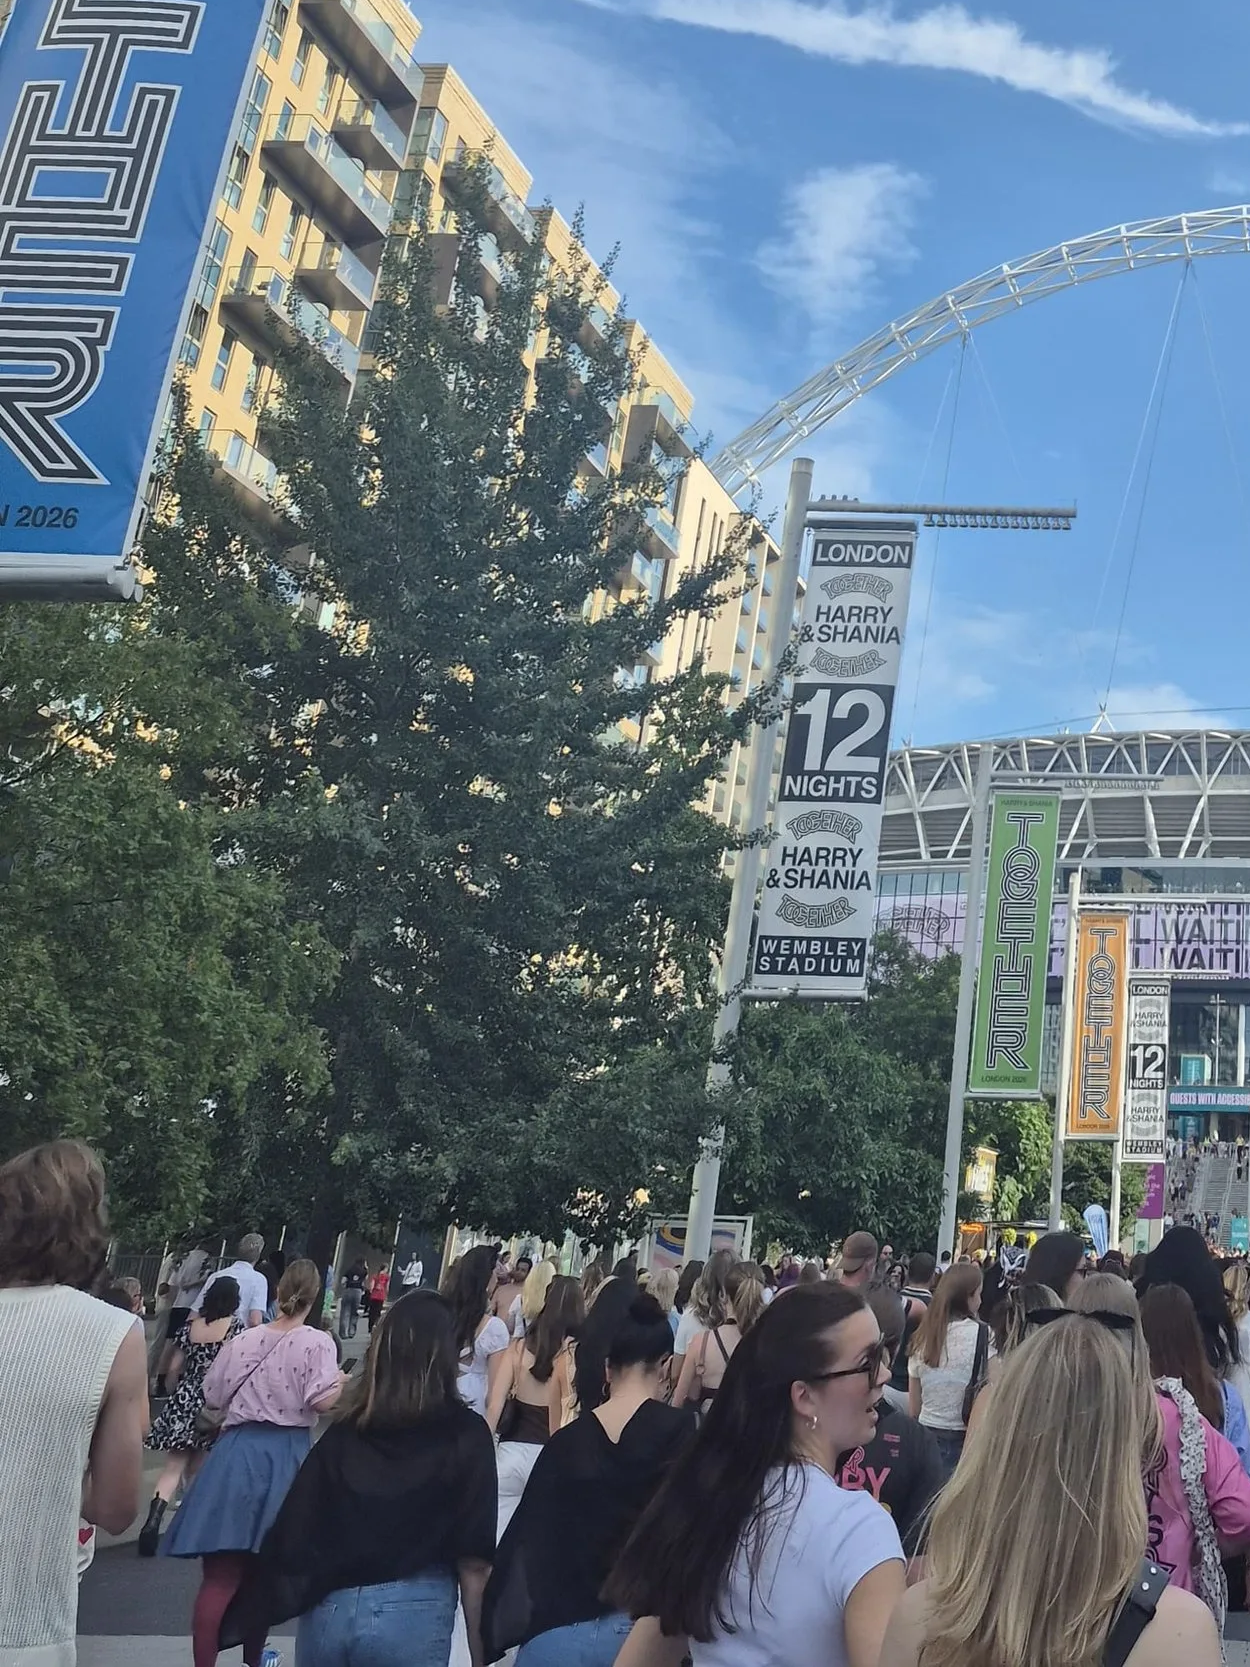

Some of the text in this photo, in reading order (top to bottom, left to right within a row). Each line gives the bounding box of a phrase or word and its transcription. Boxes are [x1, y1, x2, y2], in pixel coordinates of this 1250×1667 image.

[15, 505, 80, 529] 2026
[815, 543, 910, 564] LONDON
[820, 573, 894, 603] TOGETHER
[815, 605, 894, 624] HARRY
[809, 647, 887, 678] TOGETHER
[794, 688, 886, 772] 12
[783, 775, 878, 799] NIGHTS
[786, 809, 863, 844] TOGETHER
[781, 846, 863, 867] HARRY
[774, 894, 858, 928] TOGETHER
[762, 940, 864, 955] WEMBLEY
[985, 811, 1046, 1071] TOGETHER
[759, 956, 860, 974] STADIUM
[1132, 985, 1168, 995] LONDON
[1080, 928, 1117, 1120] TOGETHER
[1135, 1011, 1164, 1019] HARRY
[1130, 1045, 1165, 1079] 12
[1130, 1079, 1164, 1089] NIGHTS
[1198, 1093, 1216, 1104] WITH
[1131, 1107, 1160, 1115] HARRY
